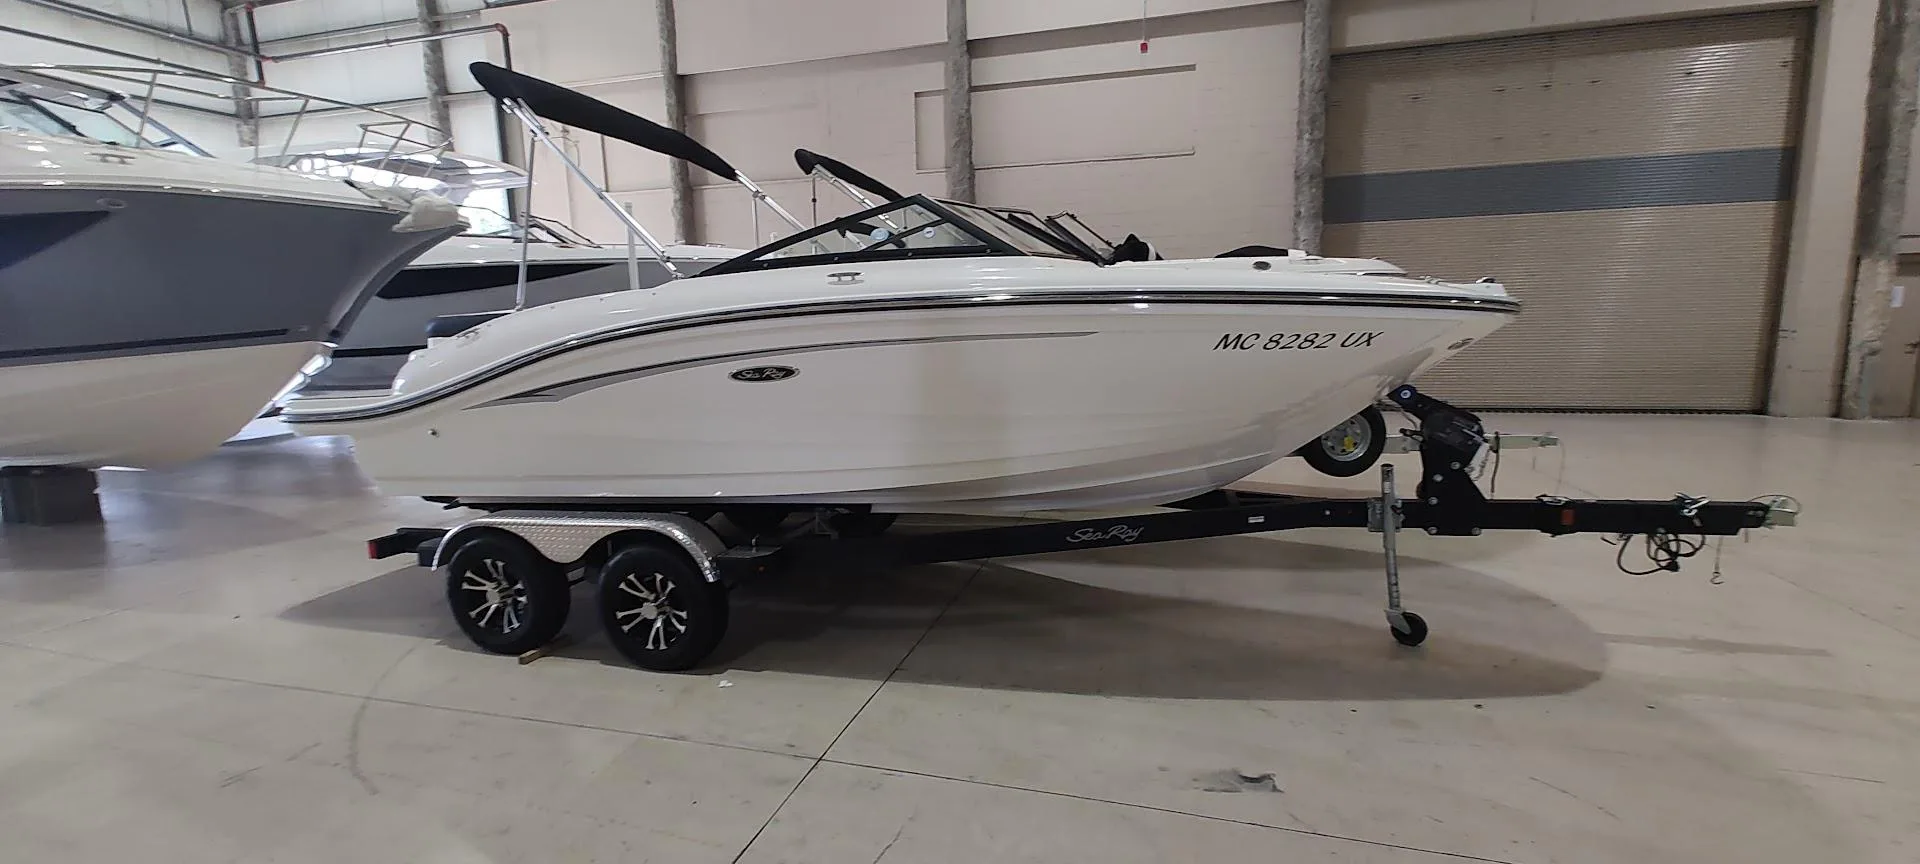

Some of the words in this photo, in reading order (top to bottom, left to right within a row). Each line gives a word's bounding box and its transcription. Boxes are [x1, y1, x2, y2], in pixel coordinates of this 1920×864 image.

[1213, 333, 1260, 350] MC
[1262, 332, 1337, 350] 8282
[1340, 331, 1384, 348] UX
[762, 367, 786, 380] Ray
[1066, 528, 1106, 542] Sea
[1106, 524, 1145, 542] Ray
